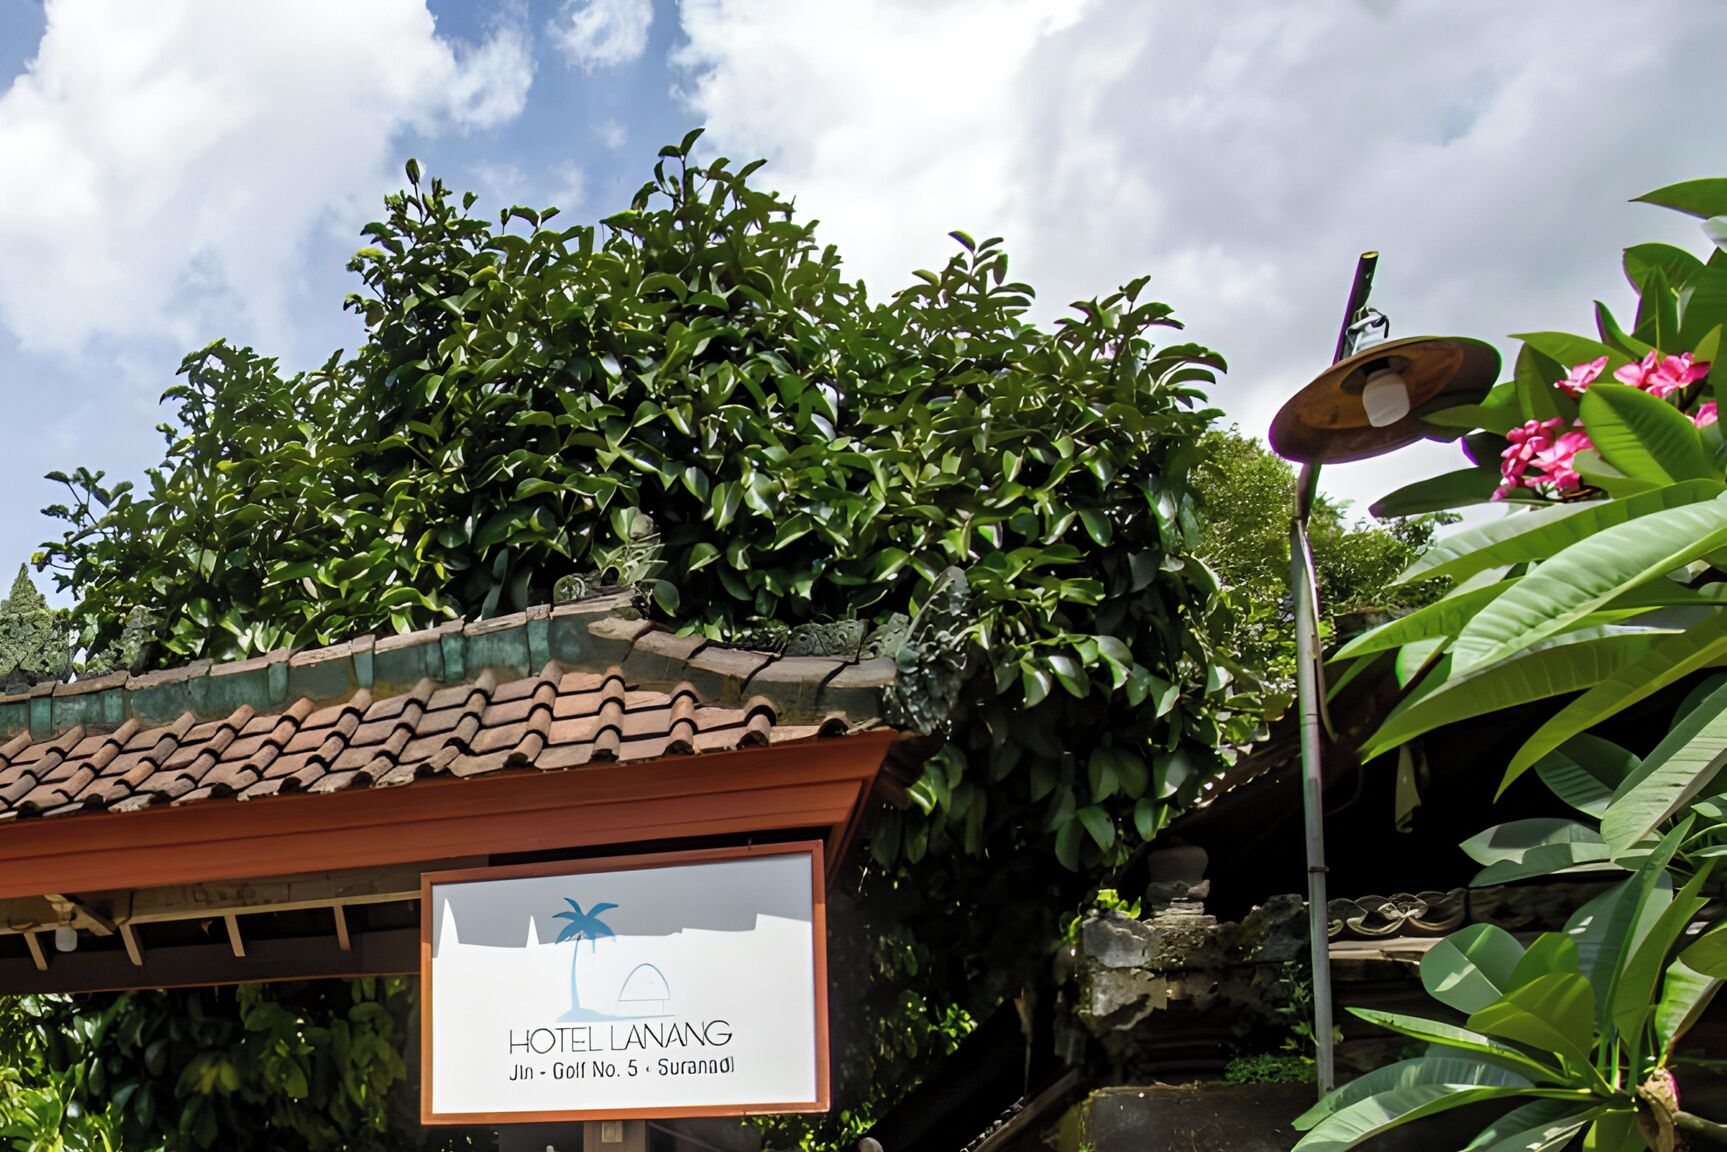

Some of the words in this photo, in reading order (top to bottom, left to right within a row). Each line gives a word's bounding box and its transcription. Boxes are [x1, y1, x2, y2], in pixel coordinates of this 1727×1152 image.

[509, 1026, 603, 1054] HOTEL
[610, 1020, 733, 1051] LANANG
[509, 1064, 533, 1080] Jln
[553, 1061, 586, 1080] Golf
[592, 1060, 620, 1078] No.
[627, 1059, 638, 1077] 5
